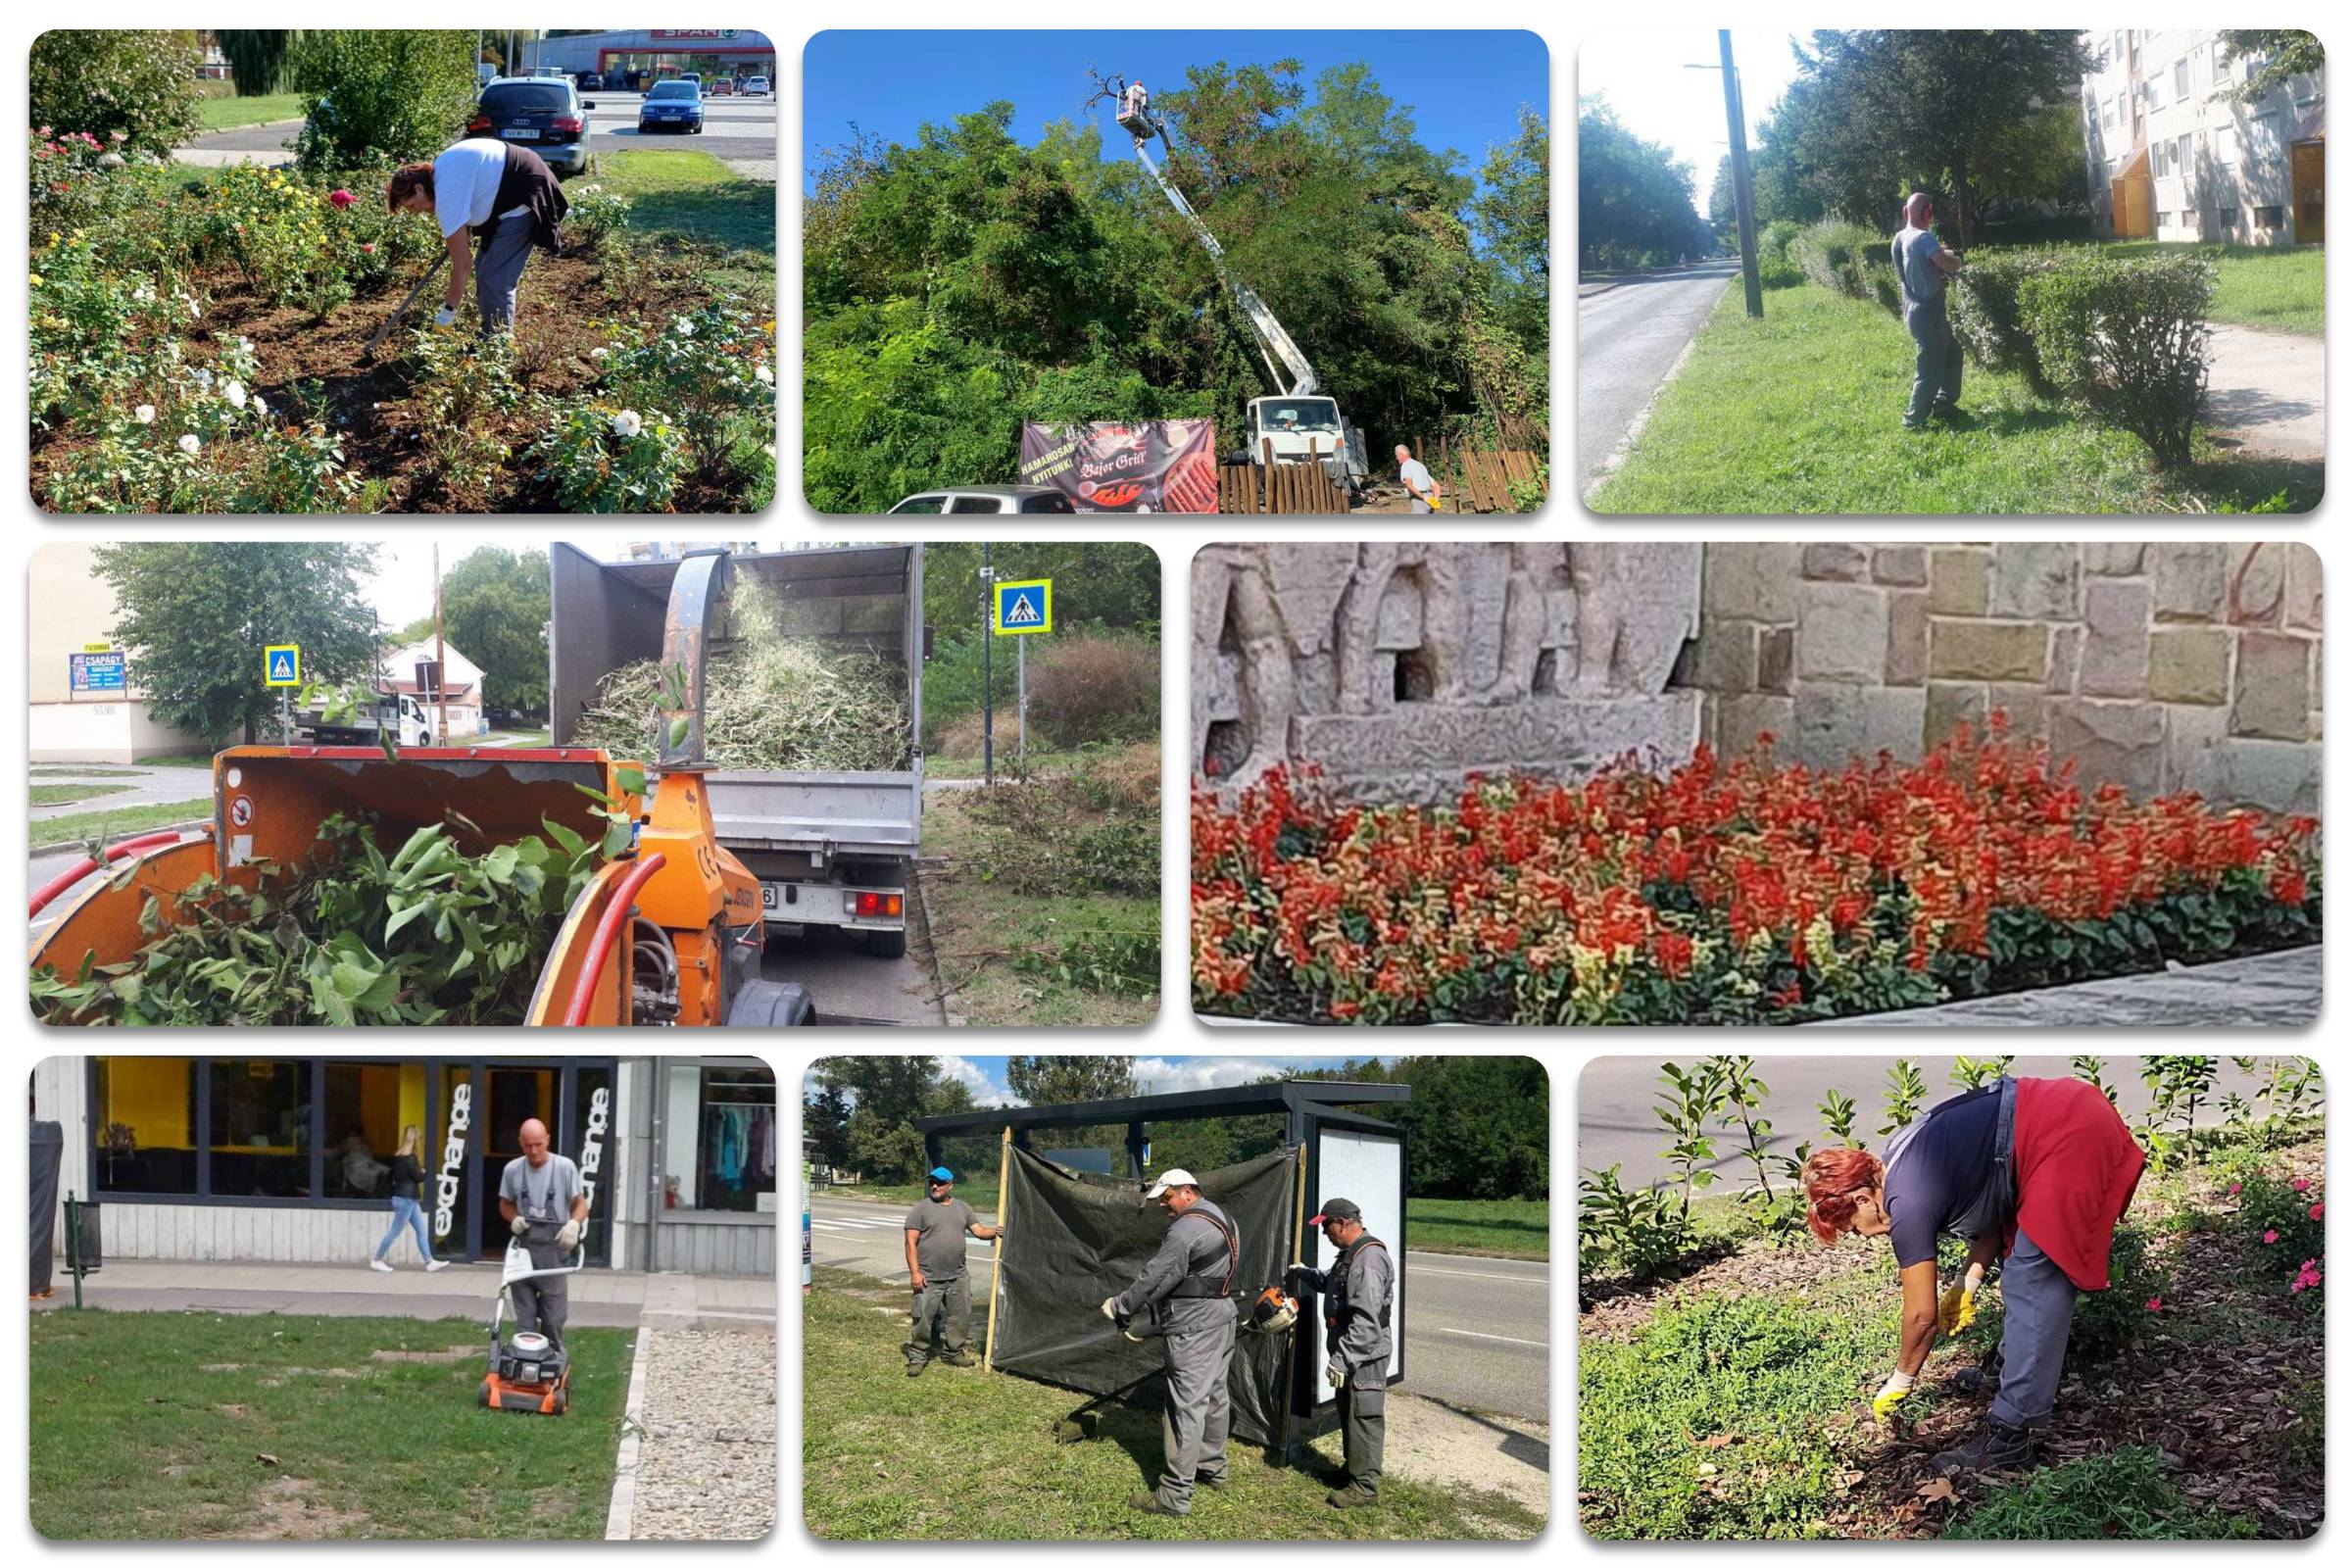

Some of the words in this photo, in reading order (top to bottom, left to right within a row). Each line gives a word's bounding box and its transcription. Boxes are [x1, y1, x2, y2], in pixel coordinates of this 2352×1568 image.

[1021, 443, 1076, 475] HAMAROSAN
[1032, 459, 1074, 485] NYITUNK!
[1080, 461, 1115, 478] Bajor
[1115, 451, 1148, 468] Grill
[435, 1084, 470, 1237] exchange
